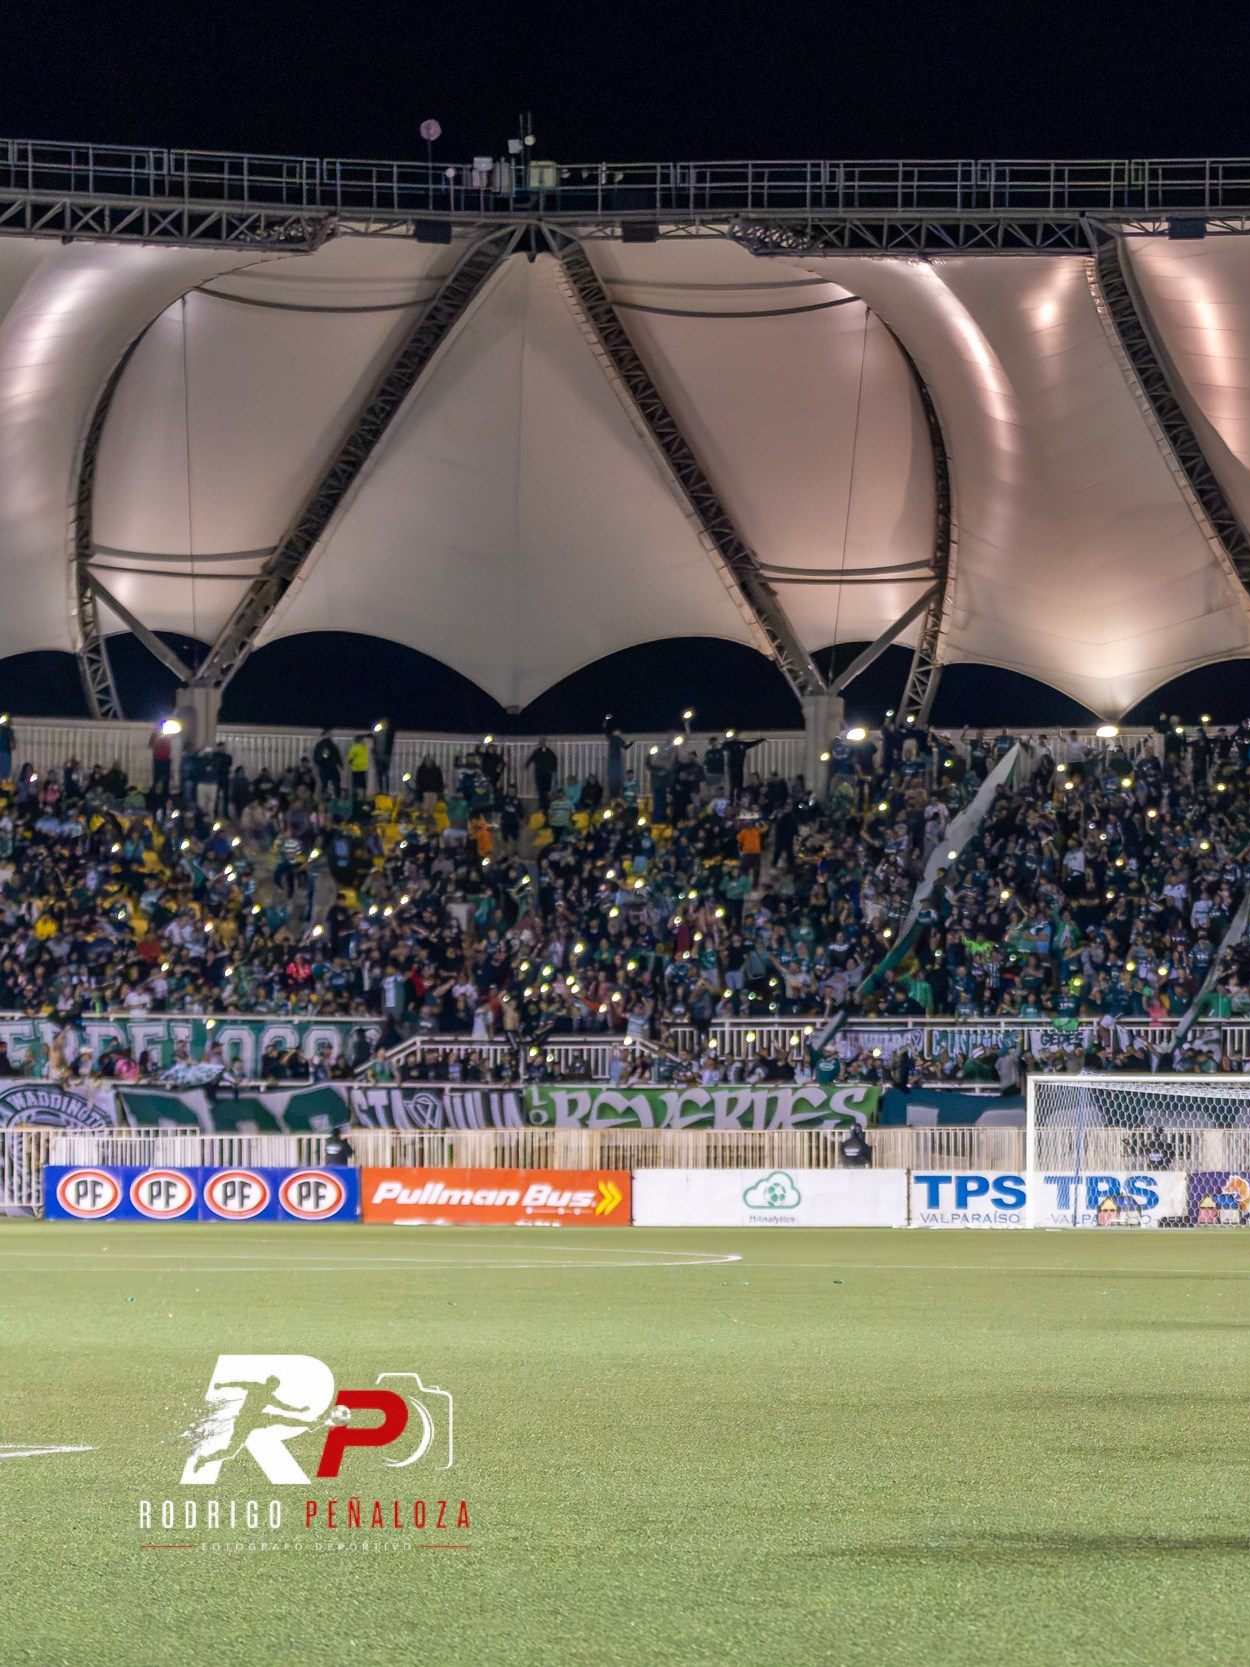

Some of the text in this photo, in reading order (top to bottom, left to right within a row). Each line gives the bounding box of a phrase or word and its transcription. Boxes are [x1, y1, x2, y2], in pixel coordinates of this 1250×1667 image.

[74, 1180, 104, 1207] PF
[148, 1180, 177, 1208] PF
[222, 1180, 251, 1208] PF
[296, 1181, 327, 1209] PF
[371, 1181, 520, 1206] Pullman
[913, 1175, 1026, 1210] TPS
[1043, 1175, 1159, 1210] TPS
[920, 1211, 1020, 1224] VALPARAÍSO
